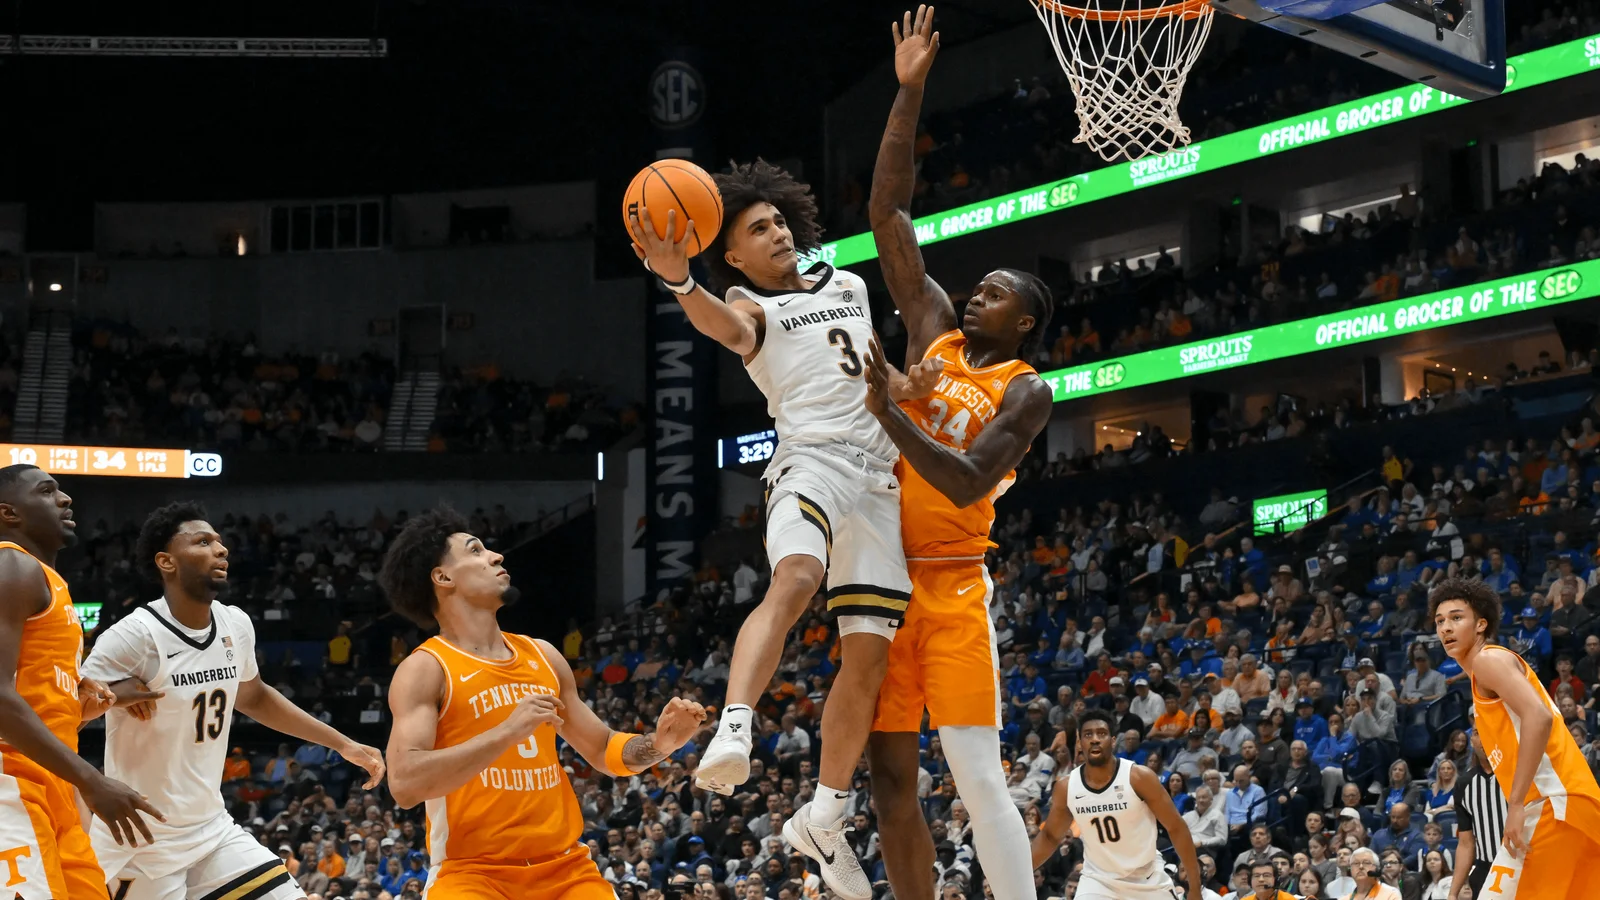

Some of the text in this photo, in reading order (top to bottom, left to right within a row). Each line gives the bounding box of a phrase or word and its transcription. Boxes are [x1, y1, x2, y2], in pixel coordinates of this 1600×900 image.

[652, 69, 698, 122] SEC
[1258, 86, 1432, 153] OFFICIAL GROCER OF
[1130, 145, 1201, 179] SPROUTS
[940, 204, 993, 237] GROCER
[996, 200, 1016, 221] OF
[1019, 190, 1047, 214] THE
[1051, 183, 1079, 206] SEC
[780, 306, 864, 332] VANDERBILT
[1315, 271, 1579, 345] OFFICIAL GROCER OF THE SEC
[826, 326, 864, 379] 3
[1179, 335, 1254, 365] SPROUTS
[1183, 353, 1249, 373] FARMERS MARKET
[1063, 370, 1092, 394] THE
[1095, 363, 1124, 388] SEC
[655, 340, 694, 518] MEANS
[920, 398, 972, 449] 34
[9, 447, 37, 466] 10
[49, 448, 78, 459] 1 PTS
[49, 459, 55, 469] 1
[93, 450, 126, 470] 34
[145, 452, 167, 462] PTS
[193, 458, 217, 473] CC
[738, 440, 774, 464] 3:29
[138, 462, 144, 472] 1
[1256, 497, 1325, 521] SPROUTS
[171, 666, 237, 687] VANDERBILT
[191, 687, 227, 744] 13
[479, 763, 561, 792] VOLUNTEER
[1075, 802, 1128, 815] VANDERBILT
[1090, 815, 1121, 844] 10
[0, 845, 31, 888] T
[1488, 865, 1516, 894] T
